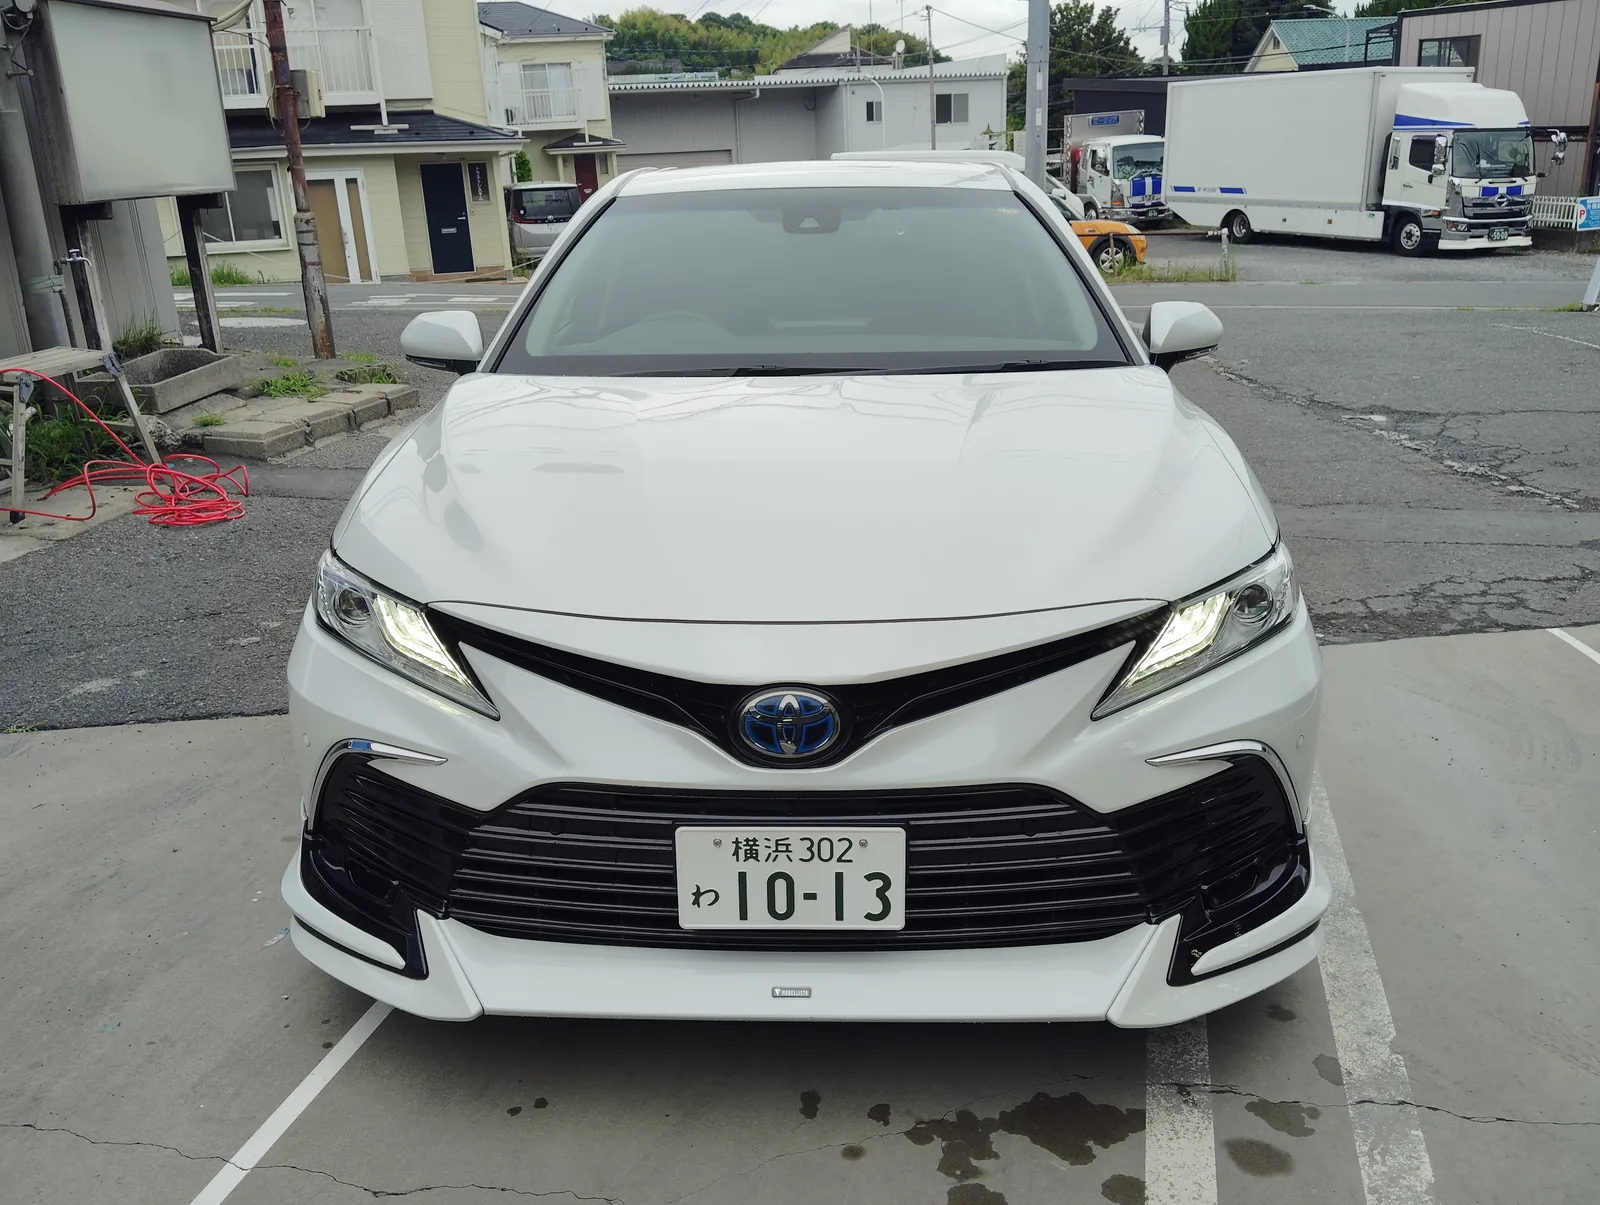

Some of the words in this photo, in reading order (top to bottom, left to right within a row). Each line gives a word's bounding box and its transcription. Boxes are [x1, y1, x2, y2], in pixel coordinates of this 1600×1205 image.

[1579, 209, 1586, 219] P
[691, 884, 720, 908] わ
[738, 871, 892, 922] 10-13
